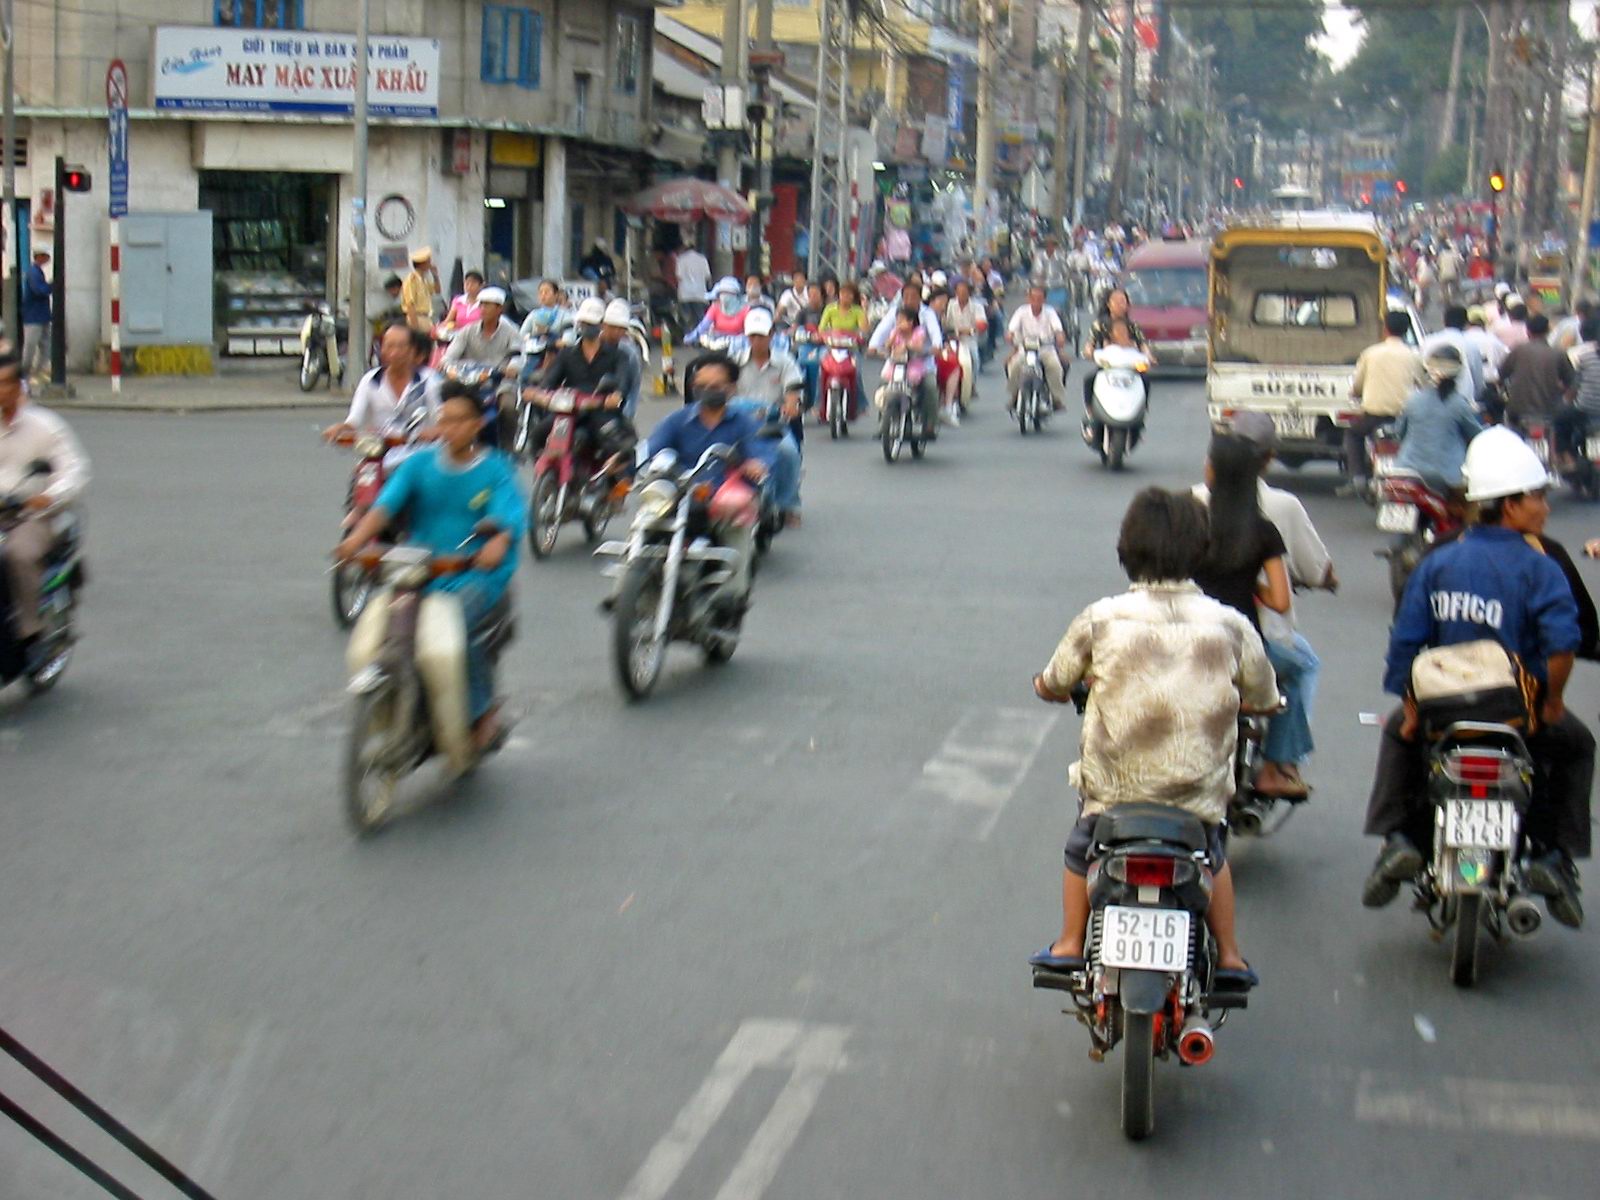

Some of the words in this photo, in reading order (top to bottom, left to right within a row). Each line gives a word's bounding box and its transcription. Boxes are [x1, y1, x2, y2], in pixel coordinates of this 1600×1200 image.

[352, 43, 373, 59] SN
[226, 62, 266, 87] MAY
[321, 61, 371, 90] XUẤ
[1117, 911, 1176, 938] 52-L6
[1116, 939, 1175, 965] 9010
